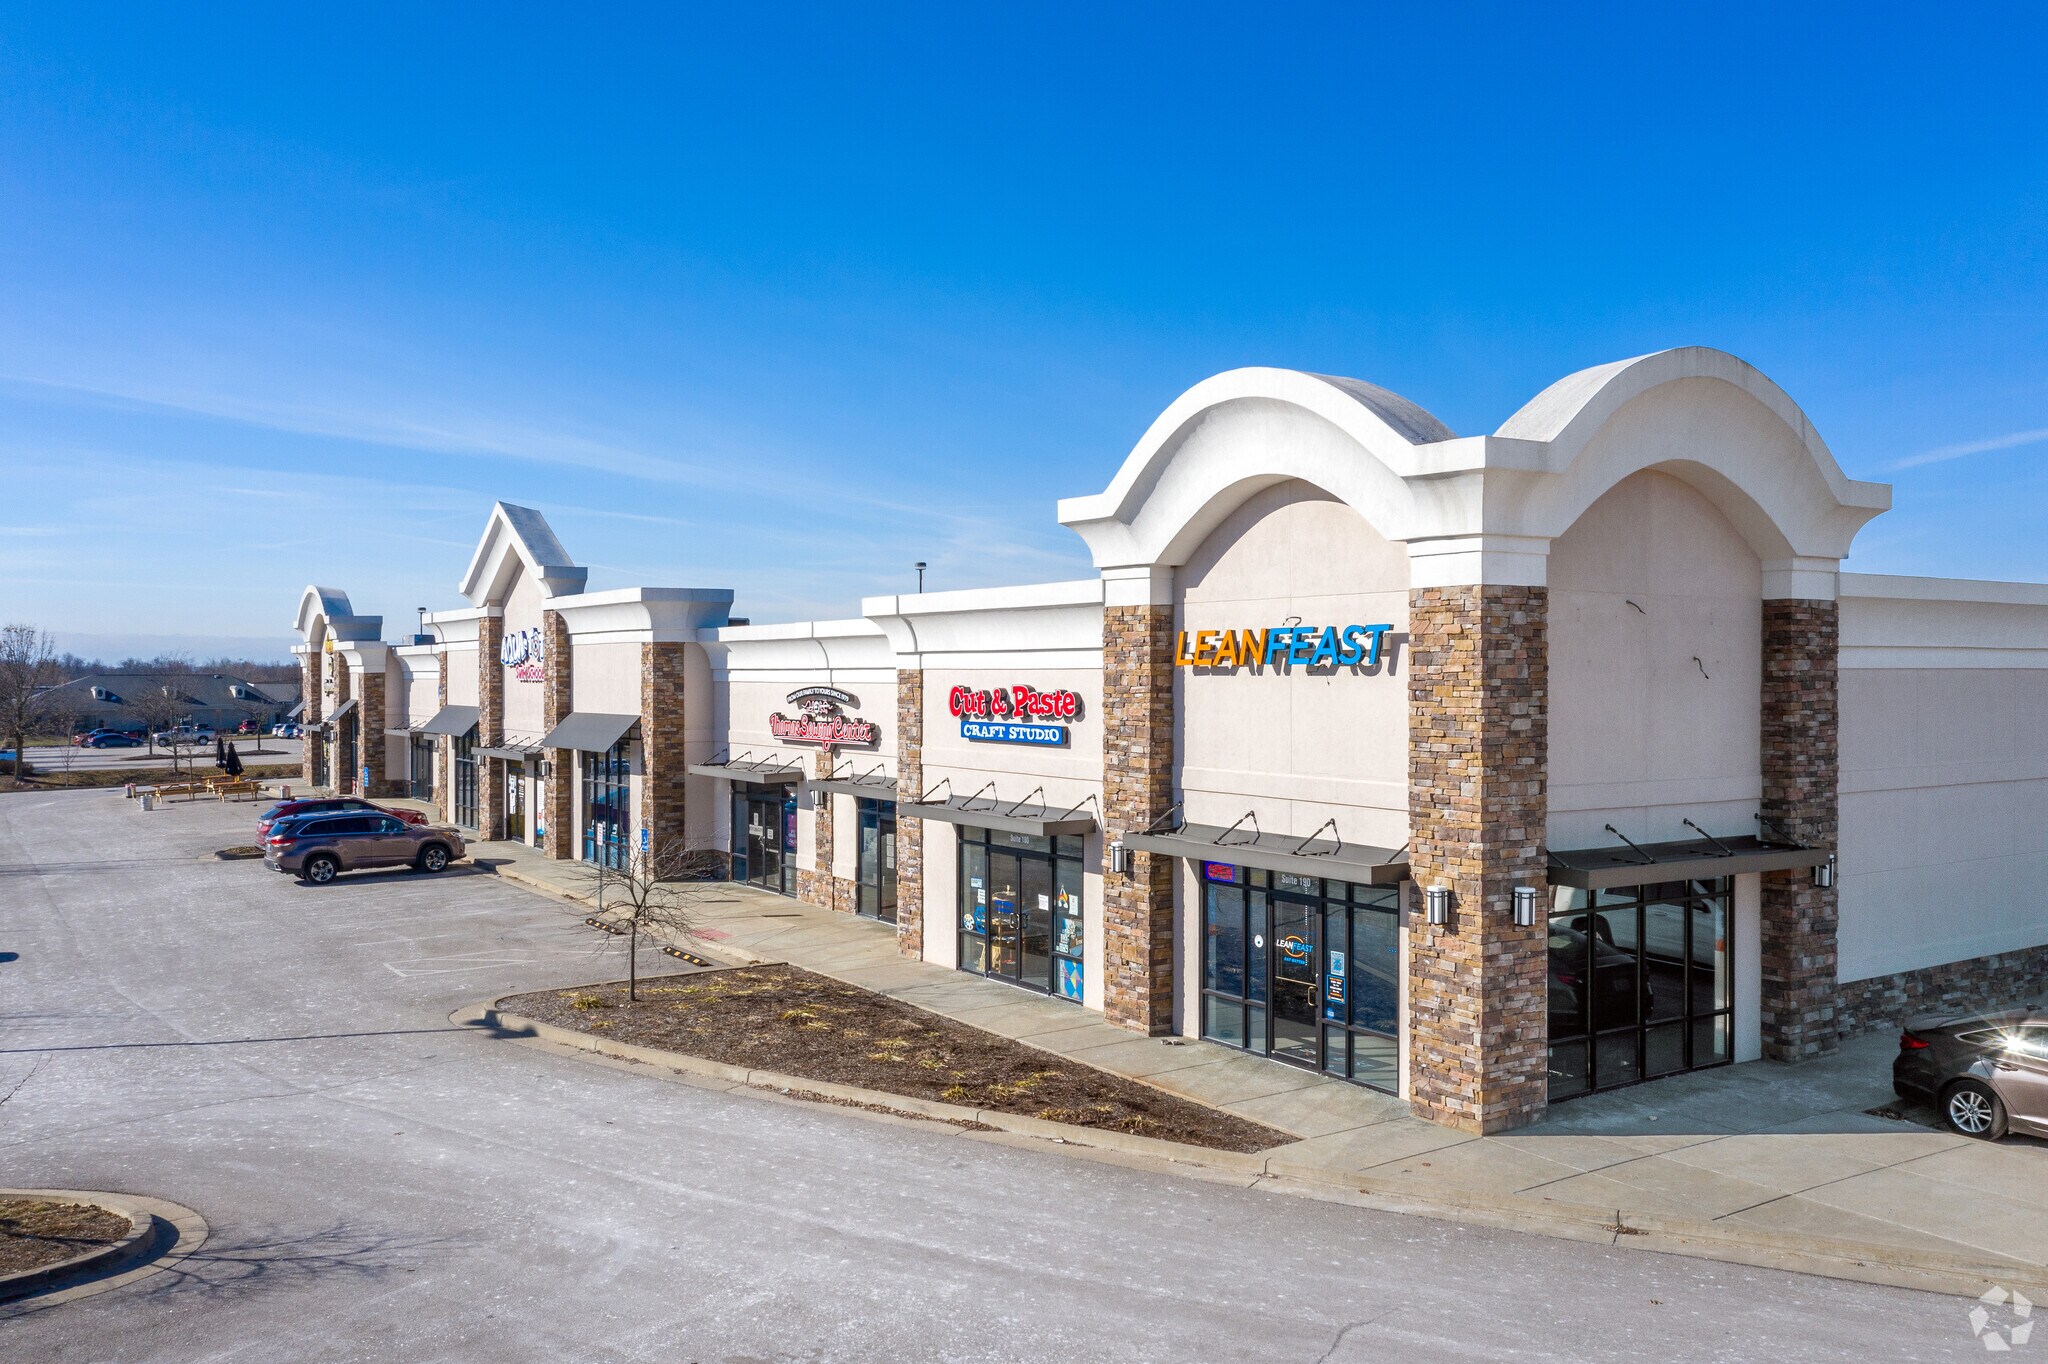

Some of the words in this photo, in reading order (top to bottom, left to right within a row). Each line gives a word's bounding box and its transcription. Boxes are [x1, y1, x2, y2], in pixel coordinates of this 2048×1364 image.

[1175, 624, 1391, 666] LEANFEAST
[949, 685, 986, 718] Cut
[991, 688, 1008, 715] &
[1012, 684, 1076, 718] Paste
[963, 724, 1006, 739] CRAFT
[1008, 726, 1060, 742] STUDIO
[1281, 874, 1298, 885] Suite
[1299, 877, 1311, 887] 190
[1276, 938, 1313, 954] LEANFEAST
